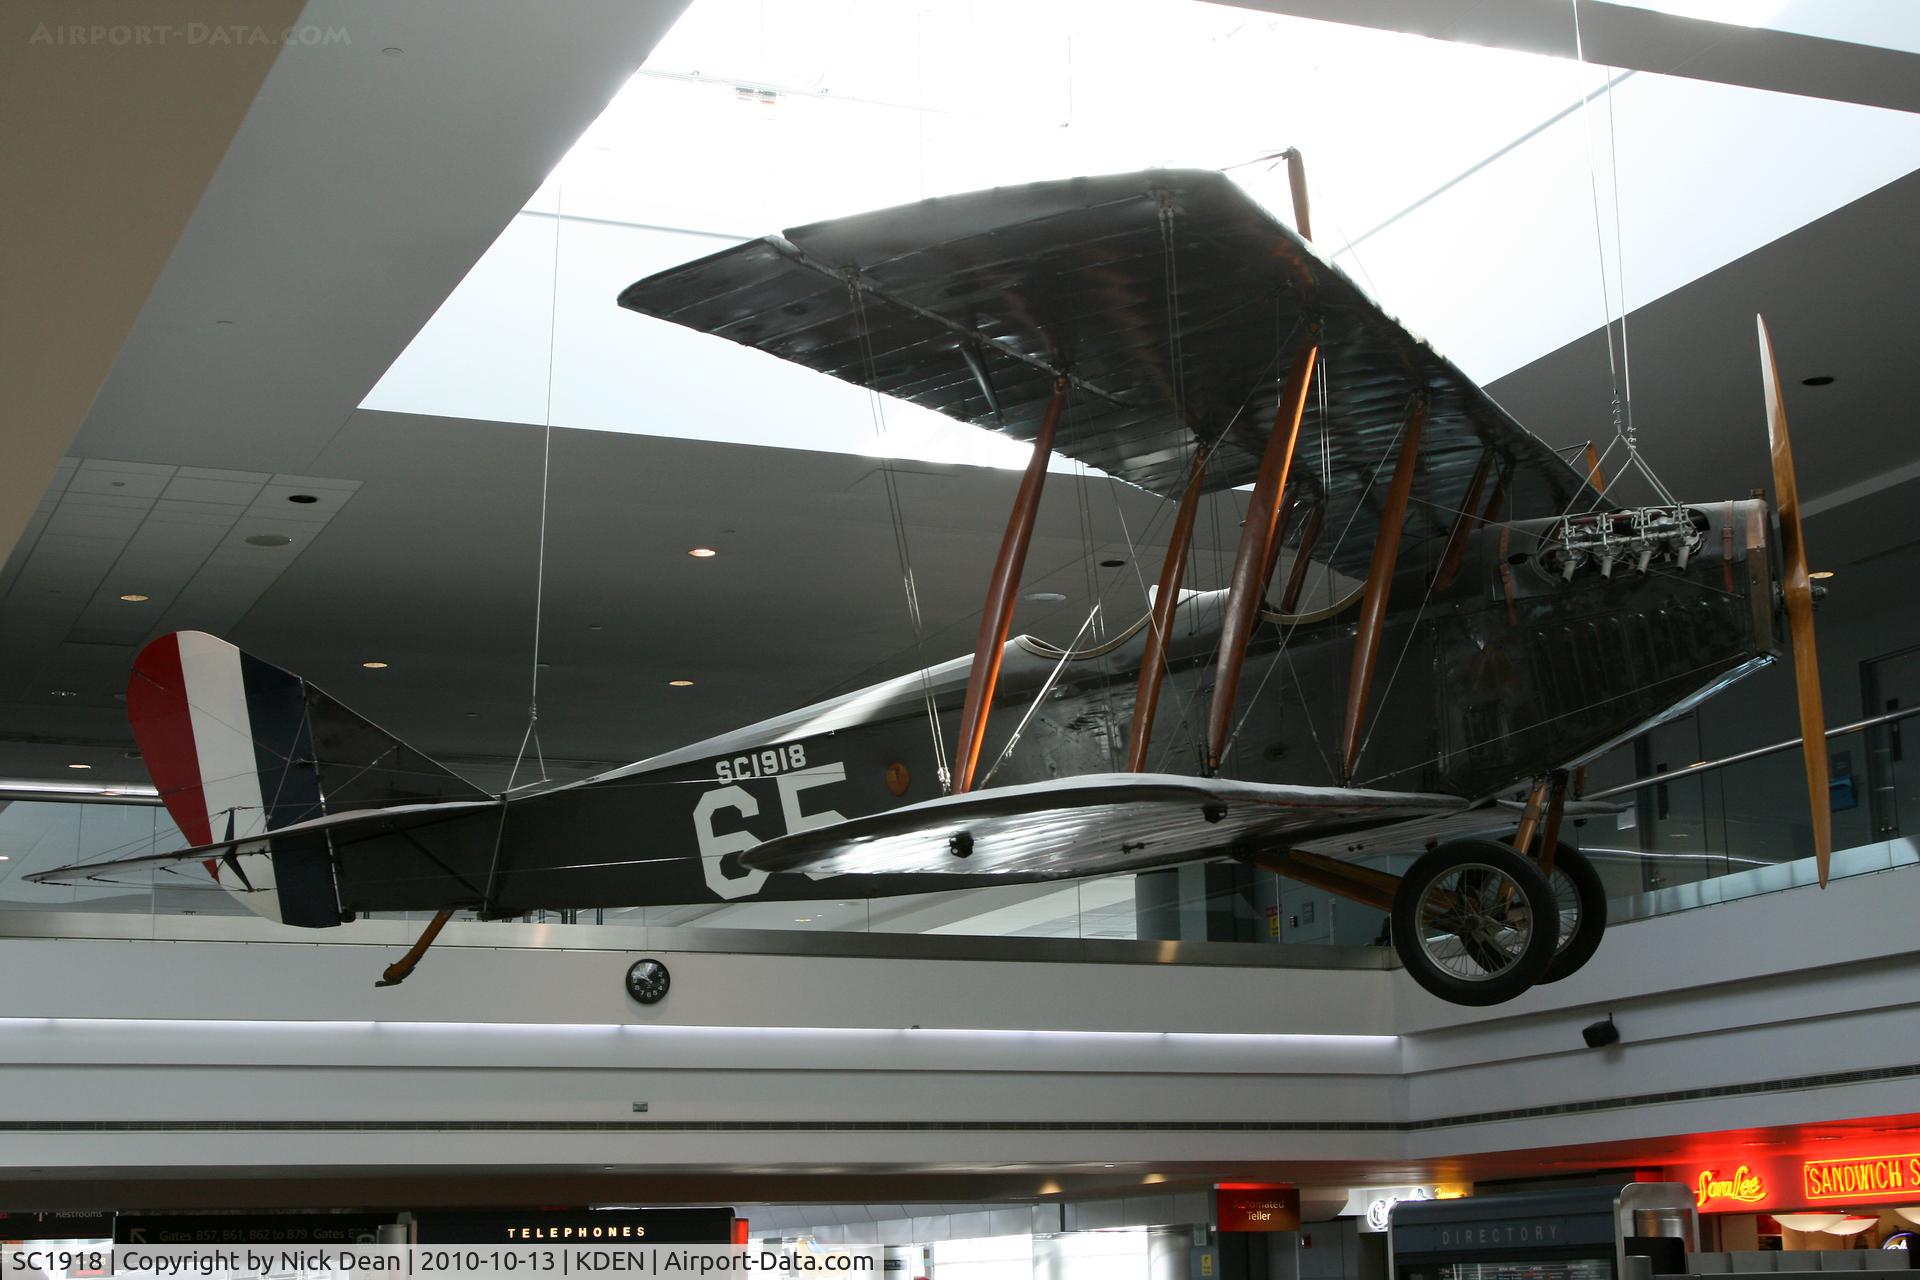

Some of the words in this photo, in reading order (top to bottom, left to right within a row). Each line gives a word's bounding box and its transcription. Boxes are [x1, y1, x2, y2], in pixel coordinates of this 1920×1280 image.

[715, 744, 807, 785] SC1918
[1808, 1160, 1902, 1194] SANDWICH
[1697, 1170, 1733, 1207] Sara
[1732, 1165, 1767, 1202] Lee
[1233, 1199, 1285, 1209] tomated
[1247, 1211, 1271, 1221] Teller
[159, 1229, 191, 1241] Gates
[313, 1229, 344, 1241] Gates
[507, 1226, 645, 1239] TELEPHONES
[1442, 1224, 1558, 1246] DIRECTORY
